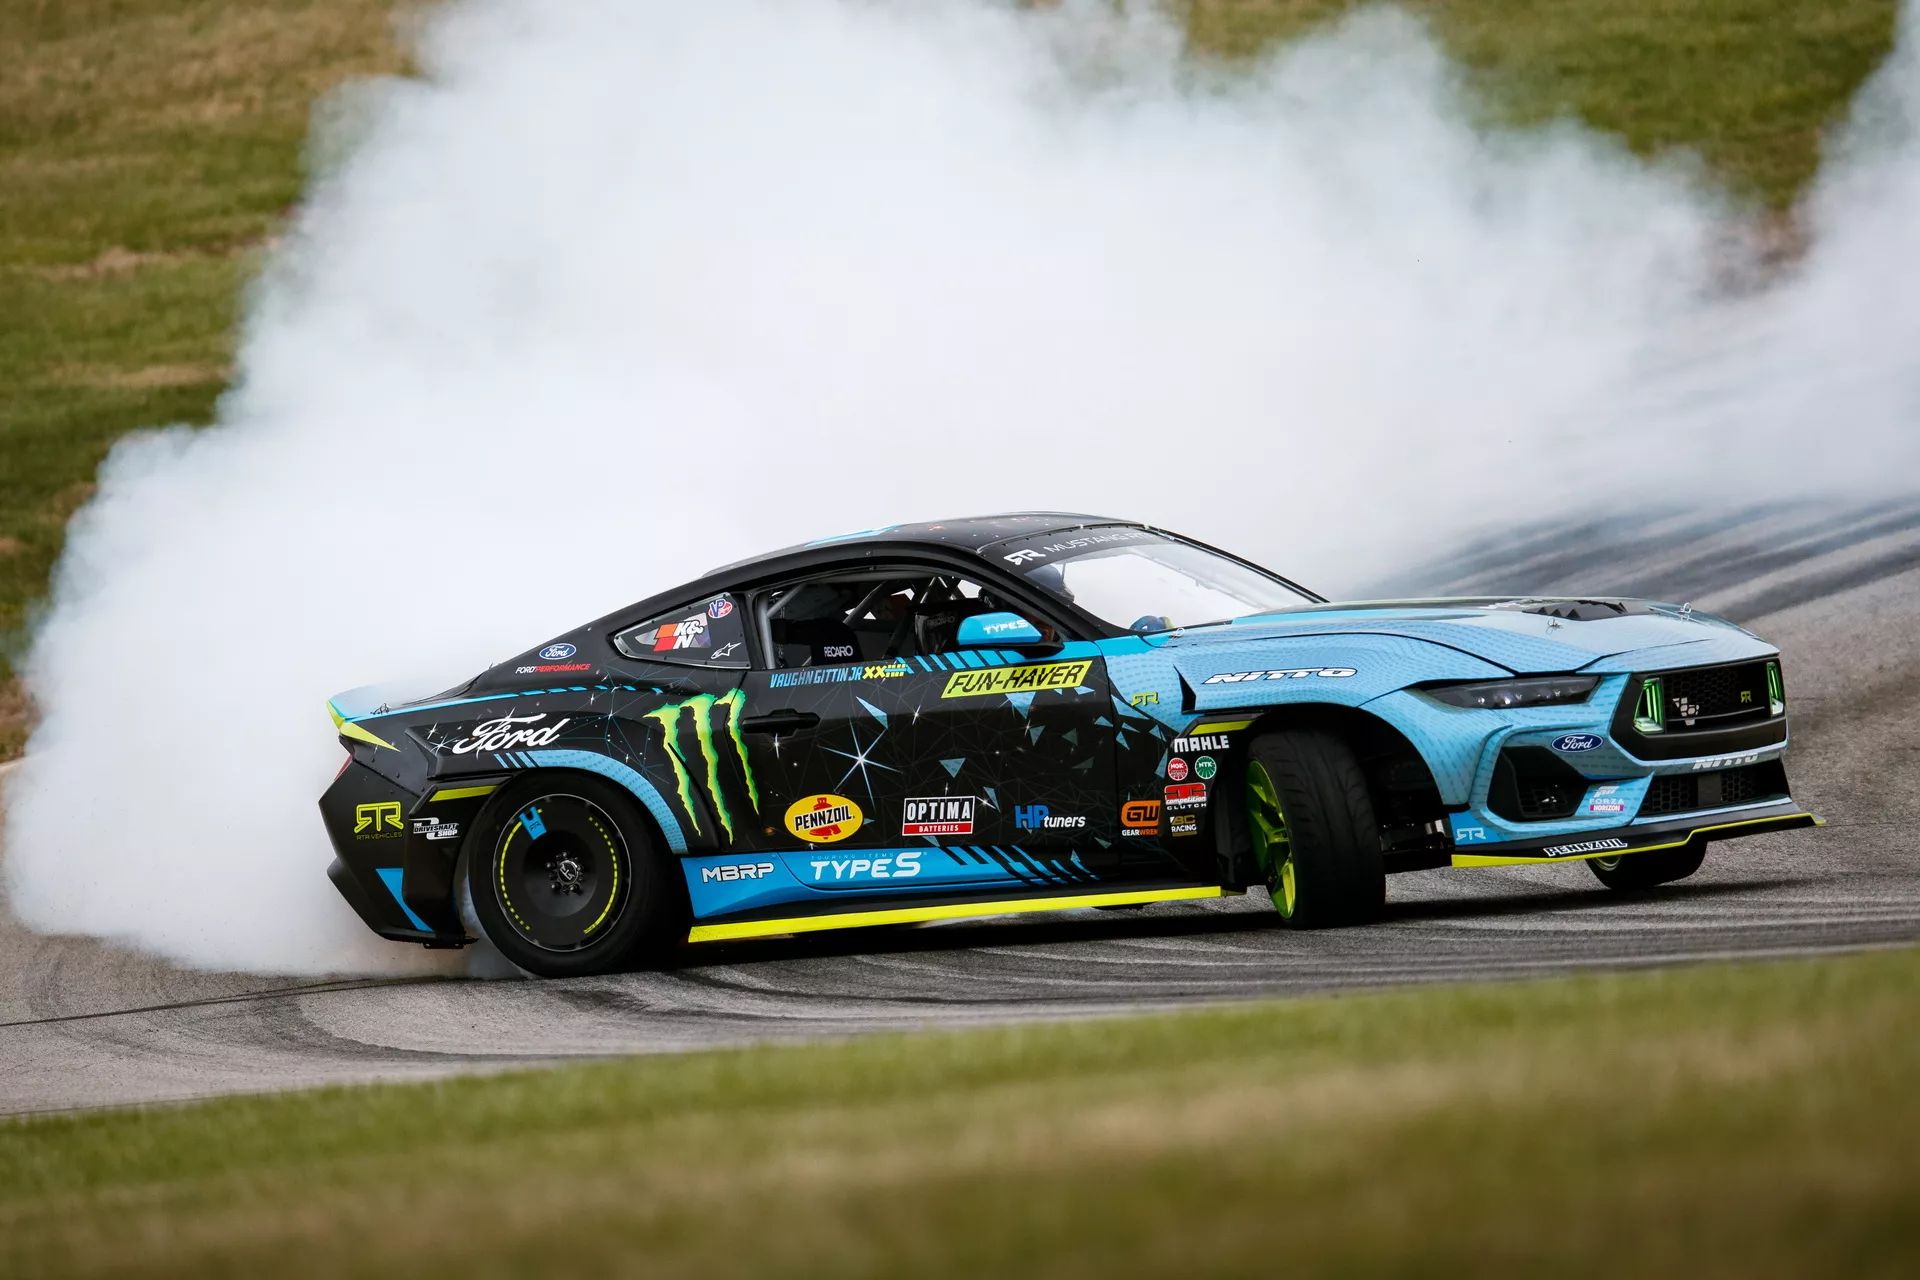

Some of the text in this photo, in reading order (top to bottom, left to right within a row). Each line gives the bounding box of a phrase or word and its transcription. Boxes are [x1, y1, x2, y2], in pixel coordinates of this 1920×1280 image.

[1043, 533, 1126, 553] MUSTANG
[544, 645, 569, 657] Ford
[823, 645, 854, 658] RECARO
[769, 670, 813, 689] VAUGHN
[812, 668, 849, 684] GITTIN
[848, 665, 863, 681] JR
[946, 664, 1085, 694] FUN-HAVER
[1201, 666, 1358, 685] NITTO
[451, 712, 571, 755] Ford
[1561, 732, 1593, 750] Ford
[1173, 735, 1230, 753] MAHLE
[1165, 795, 1207, 806] competition
[1166, 802, 1207, 811] CLUTCH
[793, 804, 853, 831] PENNZOIL
[907, 801, 971, 821] OPTIMA
[370, 832, 403, 840] VEHICLES
[414, 823, 458, 833] DRIVESHAFT
[918, 825, 959, 833] BATTERIES
[1171, 823, 1197, 833] RACING
[1543, 838, 1628, 857] PENNZOIL
[701, 861, 775, 884] MBRP
